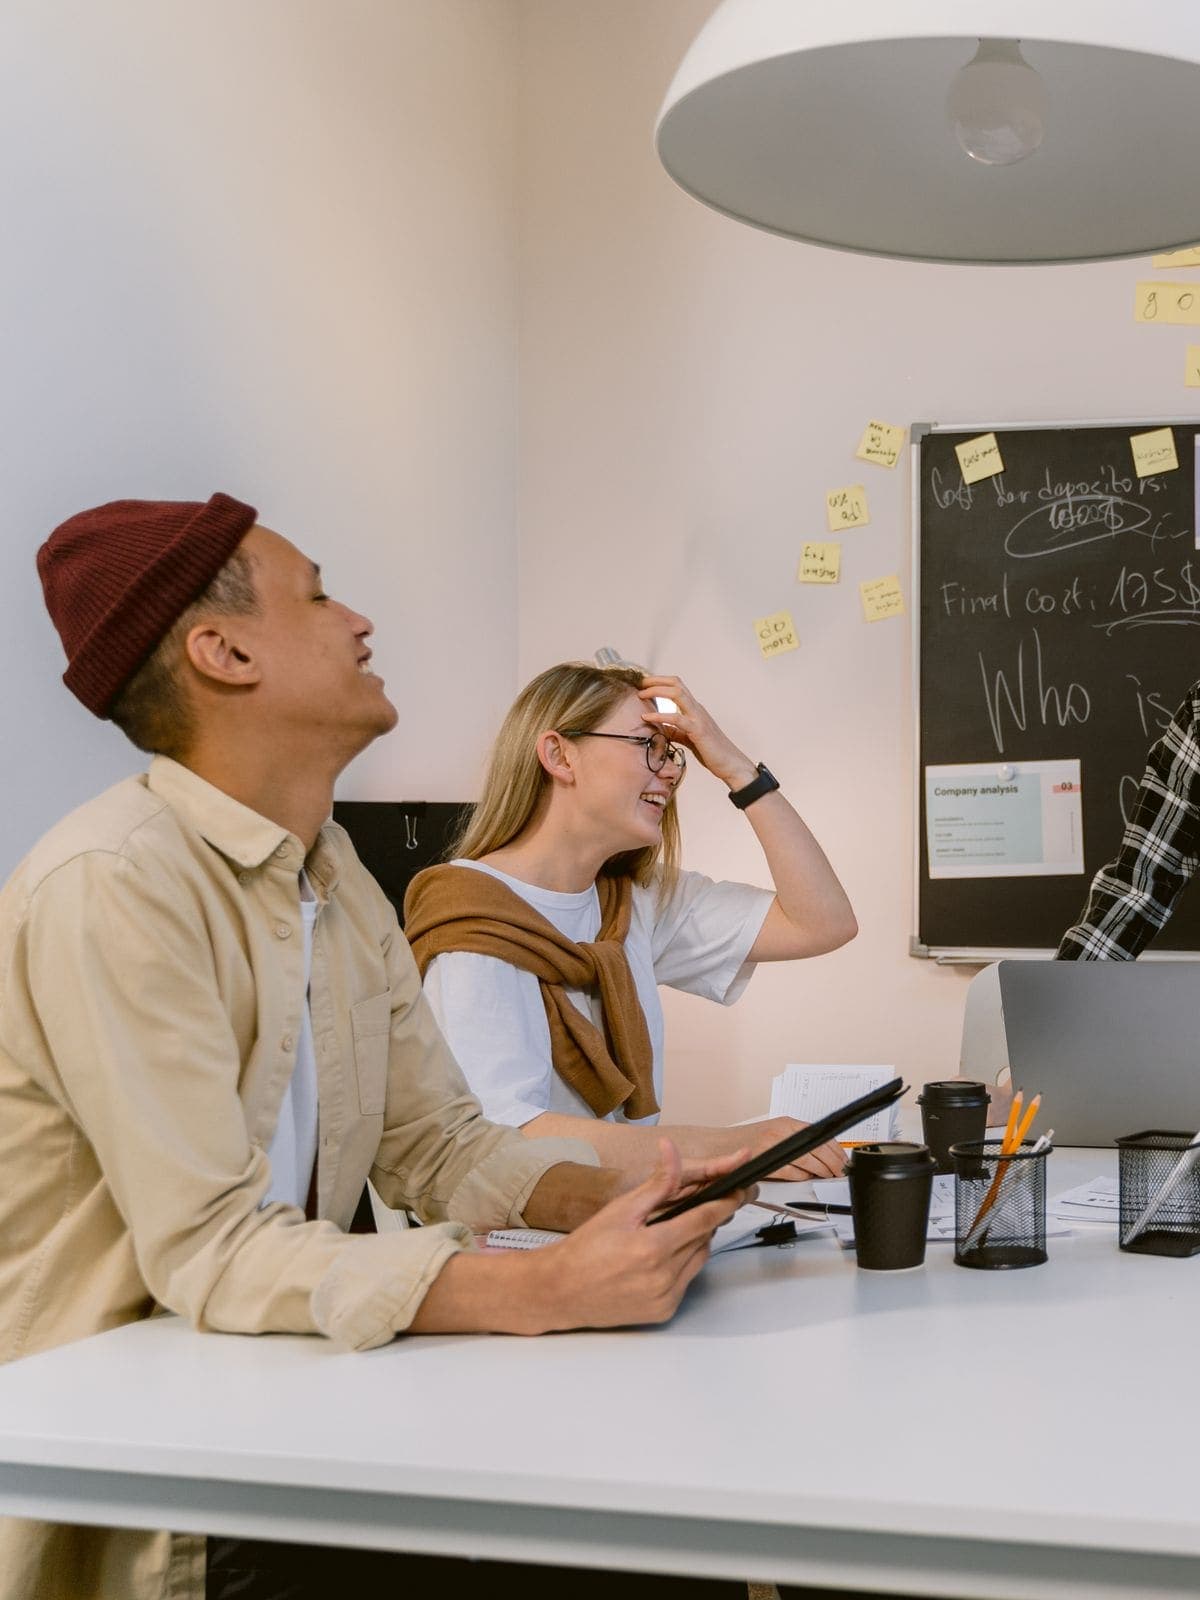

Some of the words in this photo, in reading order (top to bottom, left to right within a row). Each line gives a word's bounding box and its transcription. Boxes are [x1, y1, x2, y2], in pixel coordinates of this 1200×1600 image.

[940, 573, 1011, 618] Final
[762, 632, 793, 654] more
[978, 627, 1090, 754] Who
[934, 786, 978, 797] Company
[979, 784, 1018, 797] analysis
[1061, 781, 1073, 791] 03
